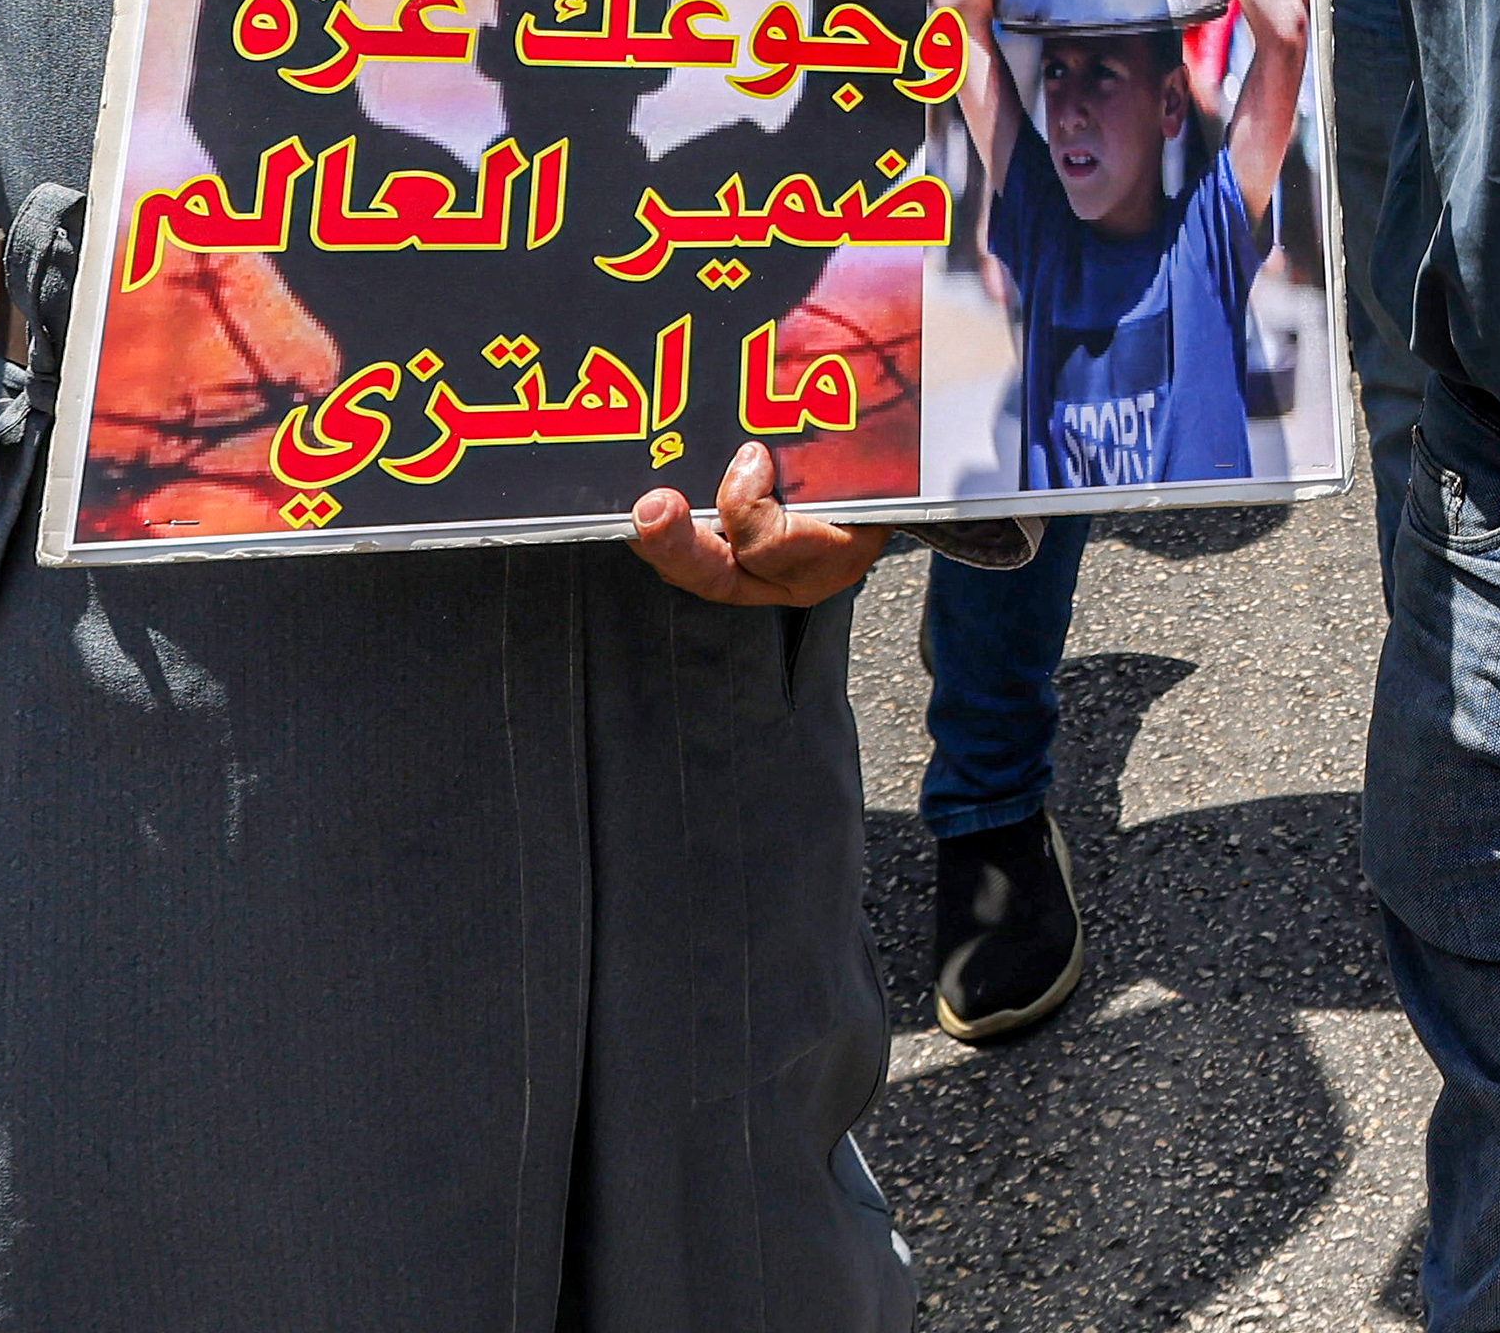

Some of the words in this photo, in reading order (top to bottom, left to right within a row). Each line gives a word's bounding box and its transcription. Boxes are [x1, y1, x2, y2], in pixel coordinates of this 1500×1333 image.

[121, 135, 570, 294] العالم
[594, 149, 953, 290] ضمير
[268, 314, 693, 531] إهتزي
[737, 319, 859, 435] ما
[1063, 392, 1156, 489] SPORT
